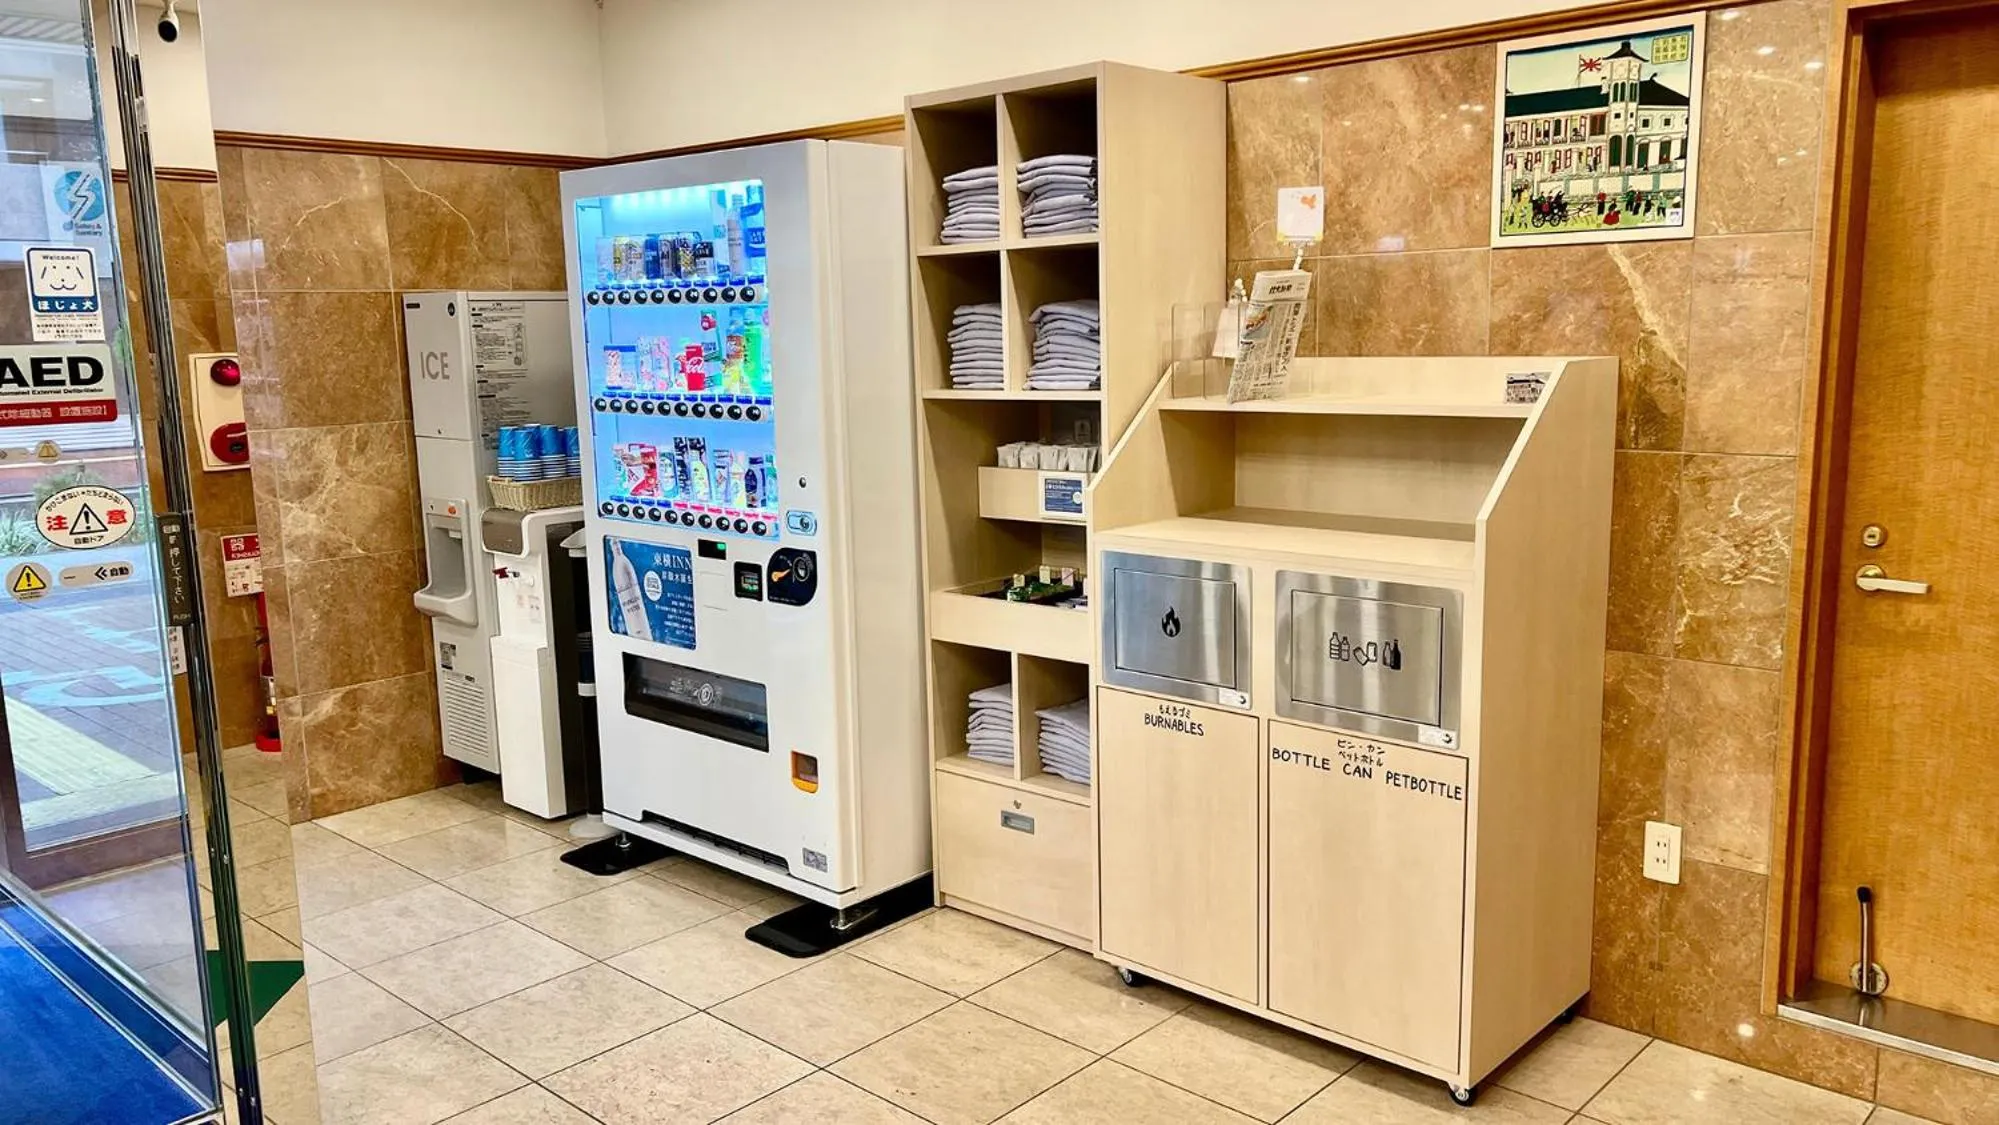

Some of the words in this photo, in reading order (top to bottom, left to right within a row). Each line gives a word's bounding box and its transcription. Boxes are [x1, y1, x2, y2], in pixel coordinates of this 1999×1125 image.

[38, 300, 95, 310] ほじょ犬
[0, 356, 104, 388] AED
[421, 352, 450, 380] ICE
[46, 515, 69, 531] 注
[106, 509, 127, 525] 意
[74, 535, 105, 545] 自動ドア
[109, 566, 130, 577] 自動
[1144, 713, 1204, 736] BURNABLES
[1272, 747, 1330, 771] BOTTLE
[1342, 763, 1373, 779] CAN
[1385, 770, 1463, 801] PETBOTTLE
